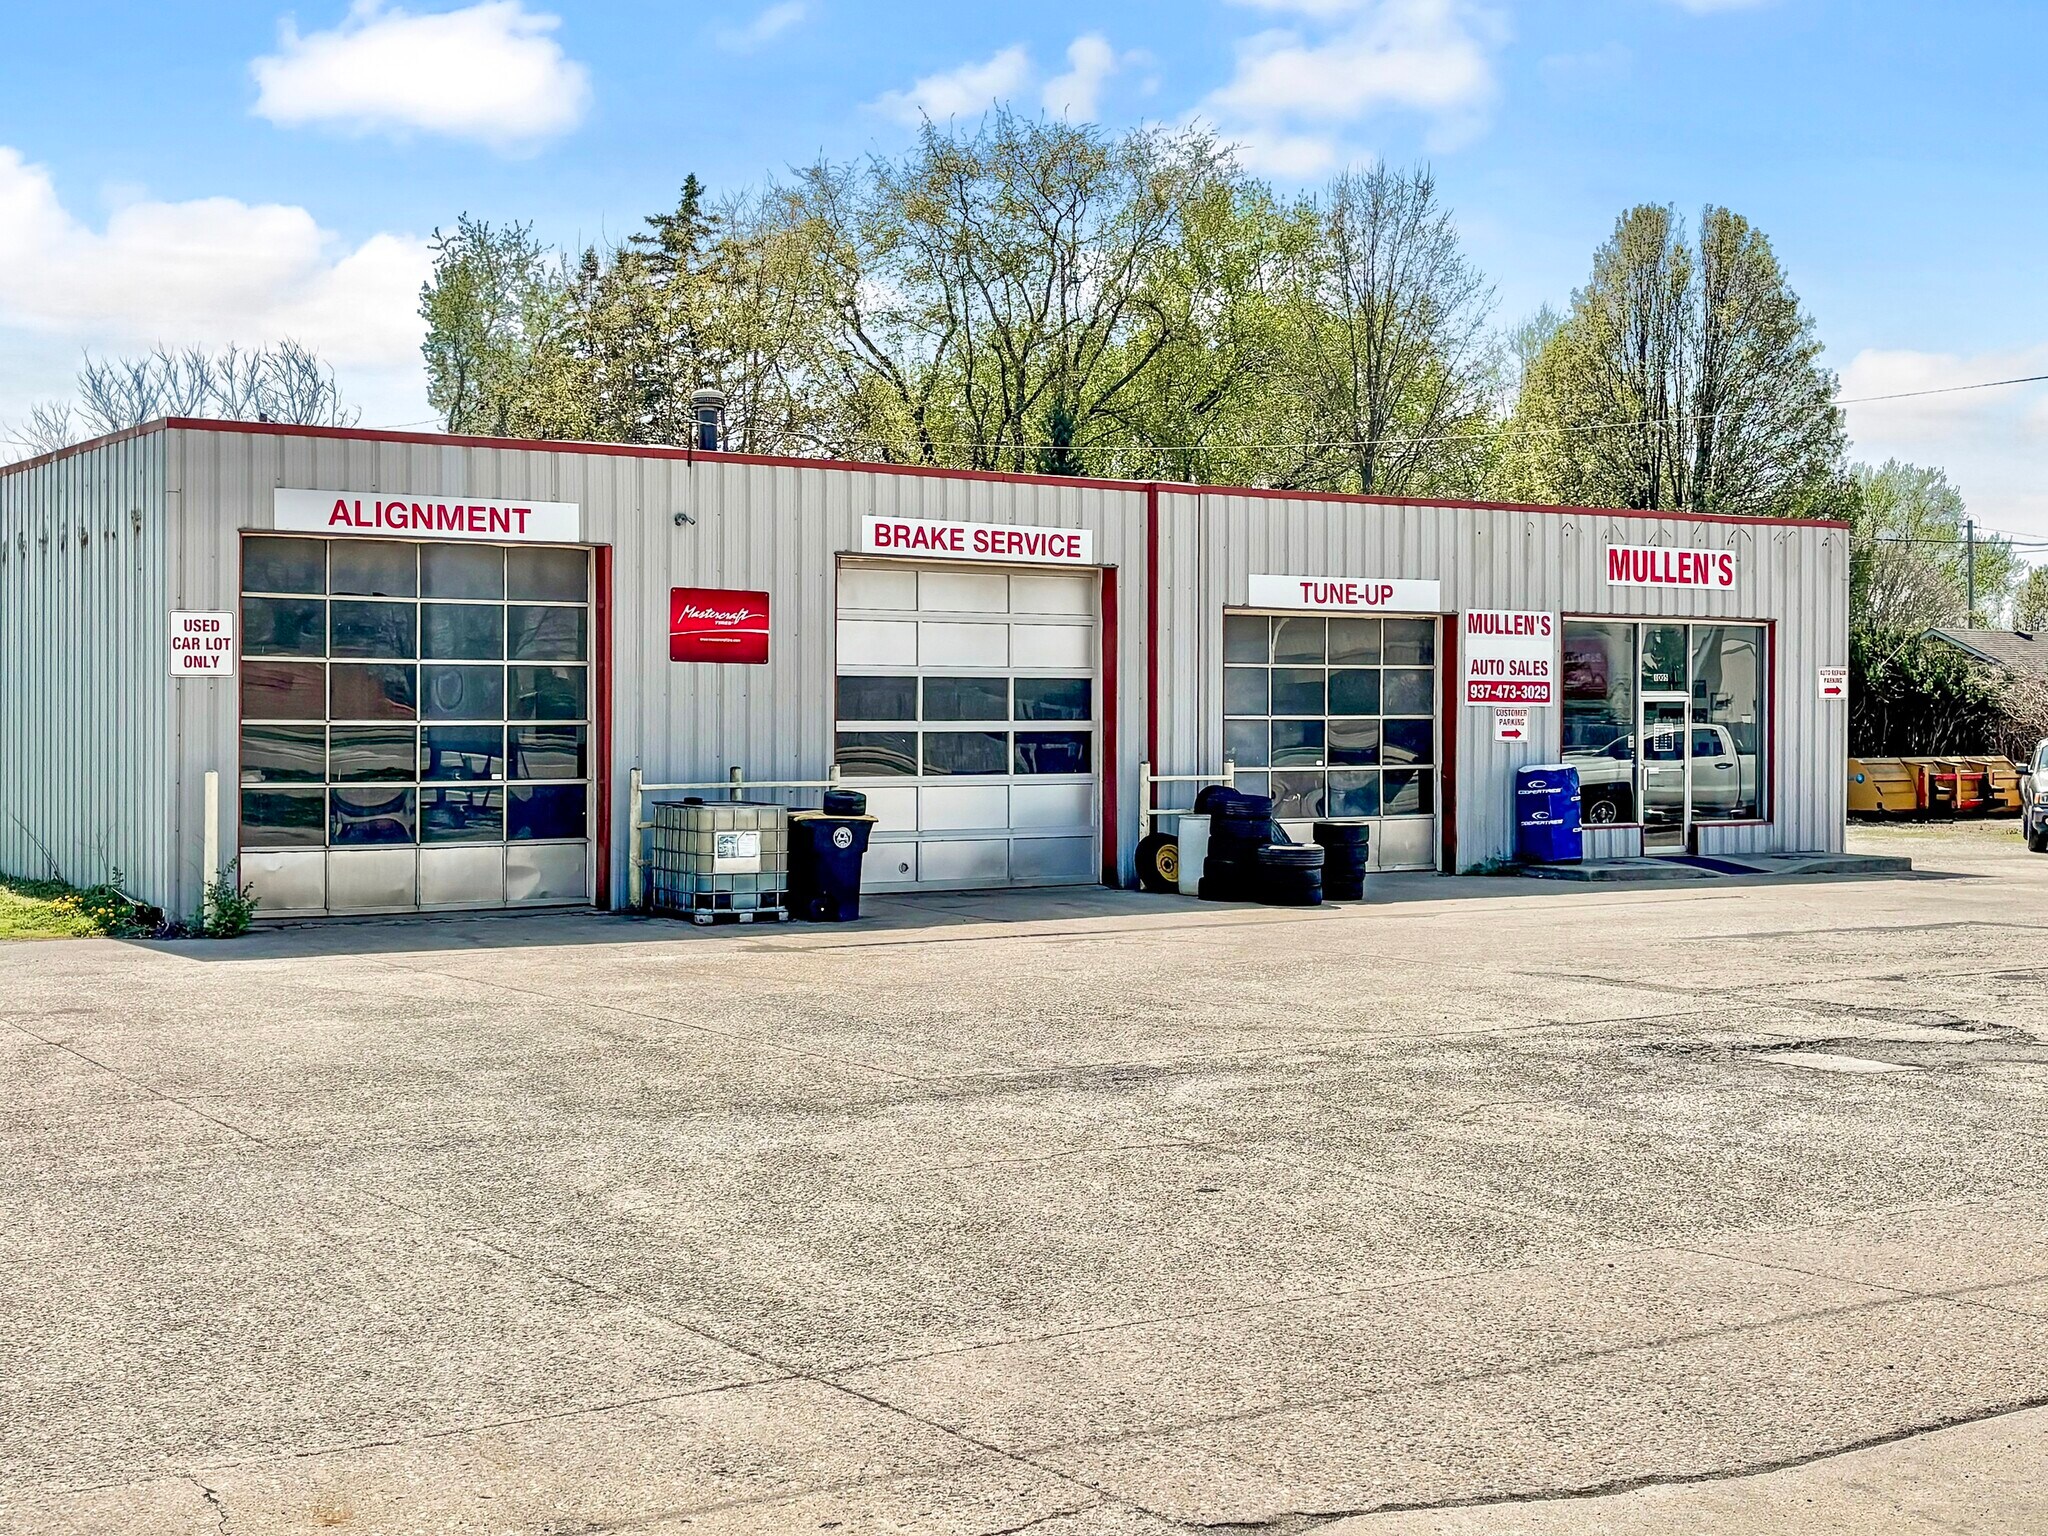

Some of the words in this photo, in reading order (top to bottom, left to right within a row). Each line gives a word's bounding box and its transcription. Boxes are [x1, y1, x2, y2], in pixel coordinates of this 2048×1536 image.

[328, 499, 532, 534] ALIGNMENT
[874, 523, 965, 551] BRAKE
[973, 529, 1081, 558] SERVICE
[1608, 548, 1733, 587] MULLEN'S
[1299, 582, 1394, 606] TUNE-UP
[677, 604, 765, 625] Mastercraft
[183, 618, 220, 632] USED
[1467, 613, 1551, 636] MULLEN'S
[172, 636, 201, 650] CAR
[205, 637, 231, 651] LOT
[183, 654, 220, 669] ONLY
[1470, 659, 1505, 676] AUTO
[1509, 660, 1549, 677] SALES
[1470, 684, 1549, 700] 937-473-3029
[1495, 708, 1528, 718] CUSTOMER
[1498, 718, 1525, 727] PARKING
